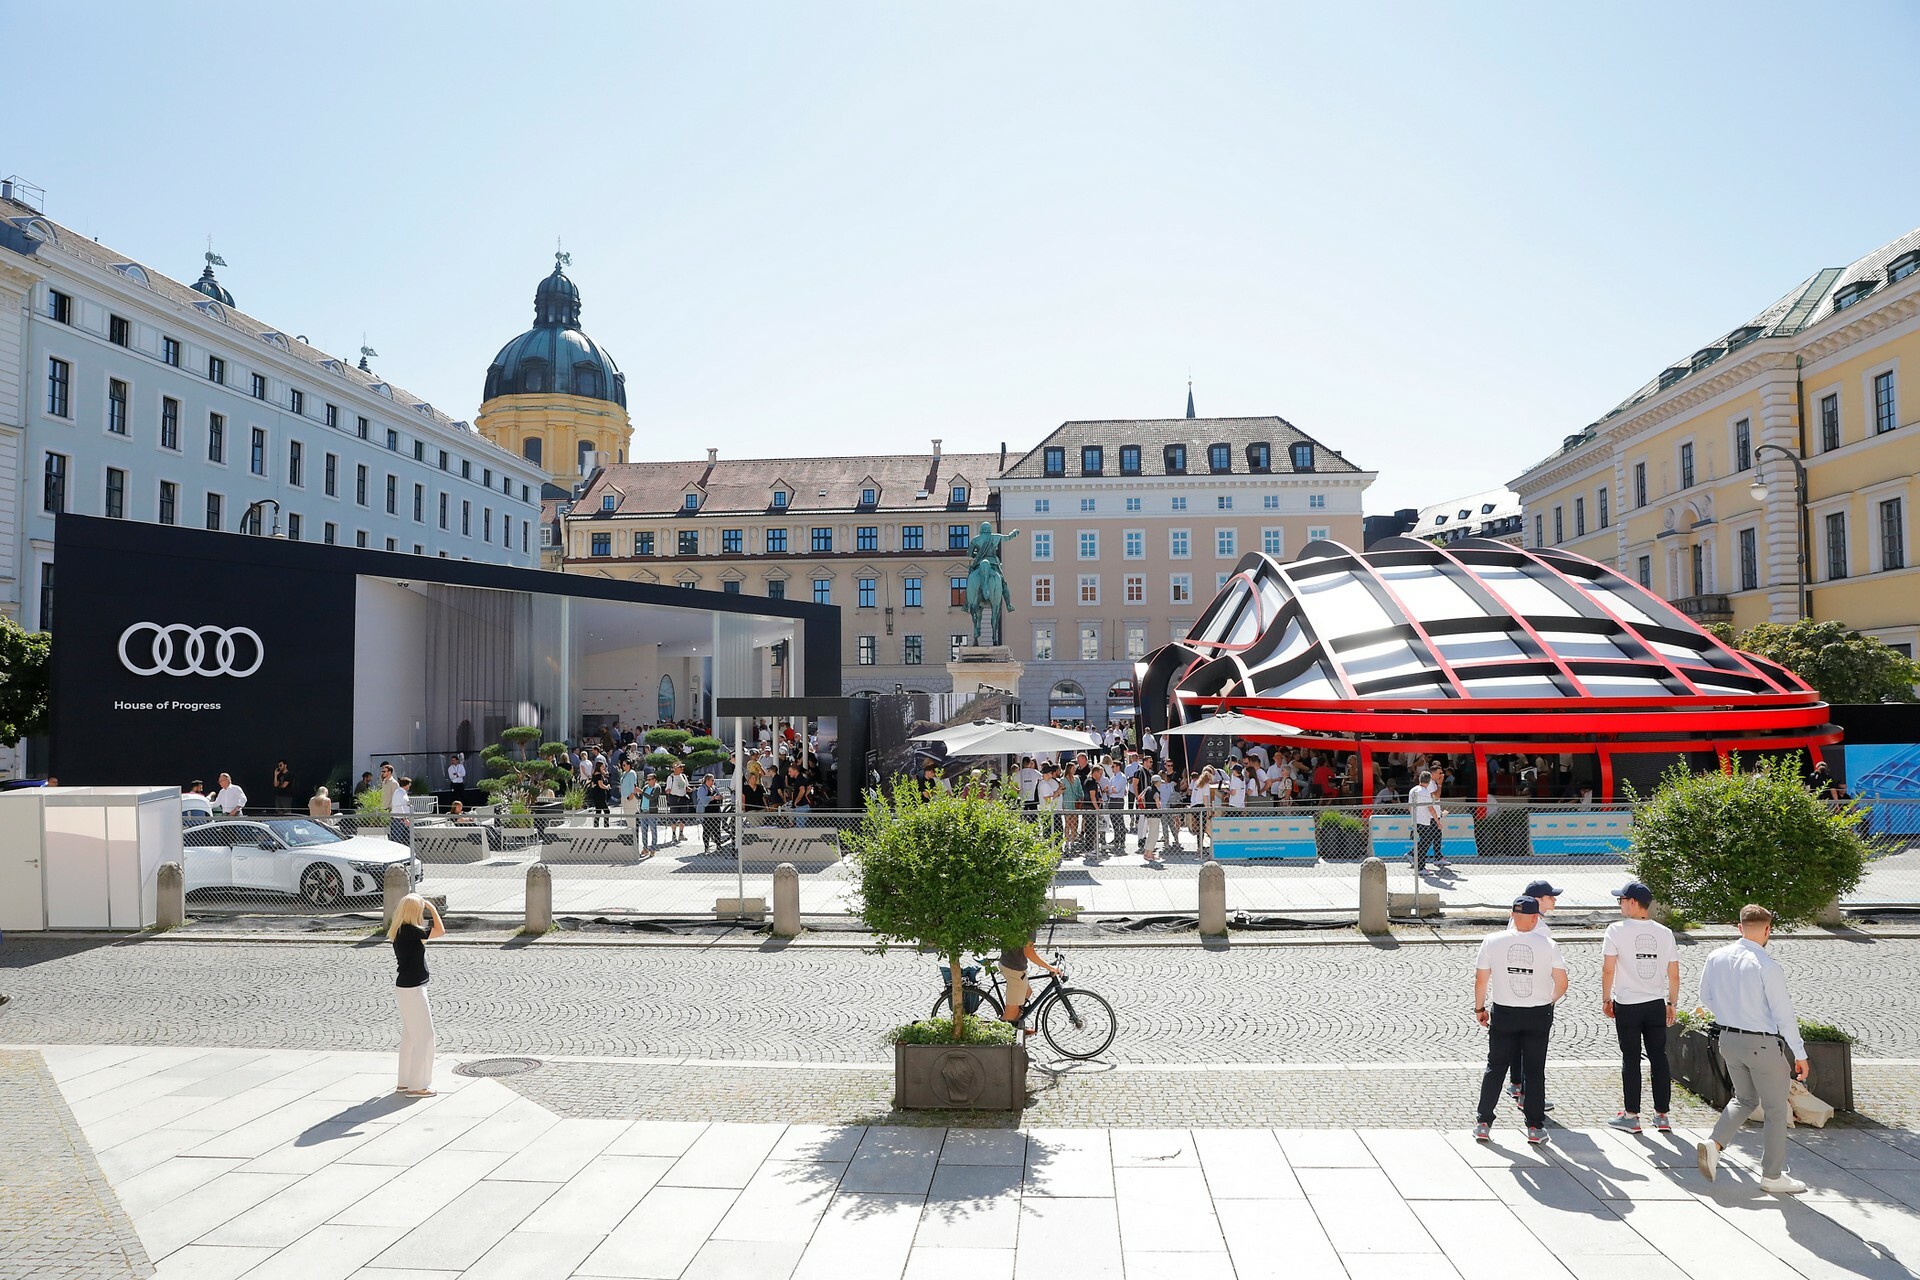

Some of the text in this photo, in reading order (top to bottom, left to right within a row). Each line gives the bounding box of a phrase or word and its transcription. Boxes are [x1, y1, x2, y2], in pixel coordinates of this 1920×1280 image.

[114, 701, 221, 712] House of Progress
